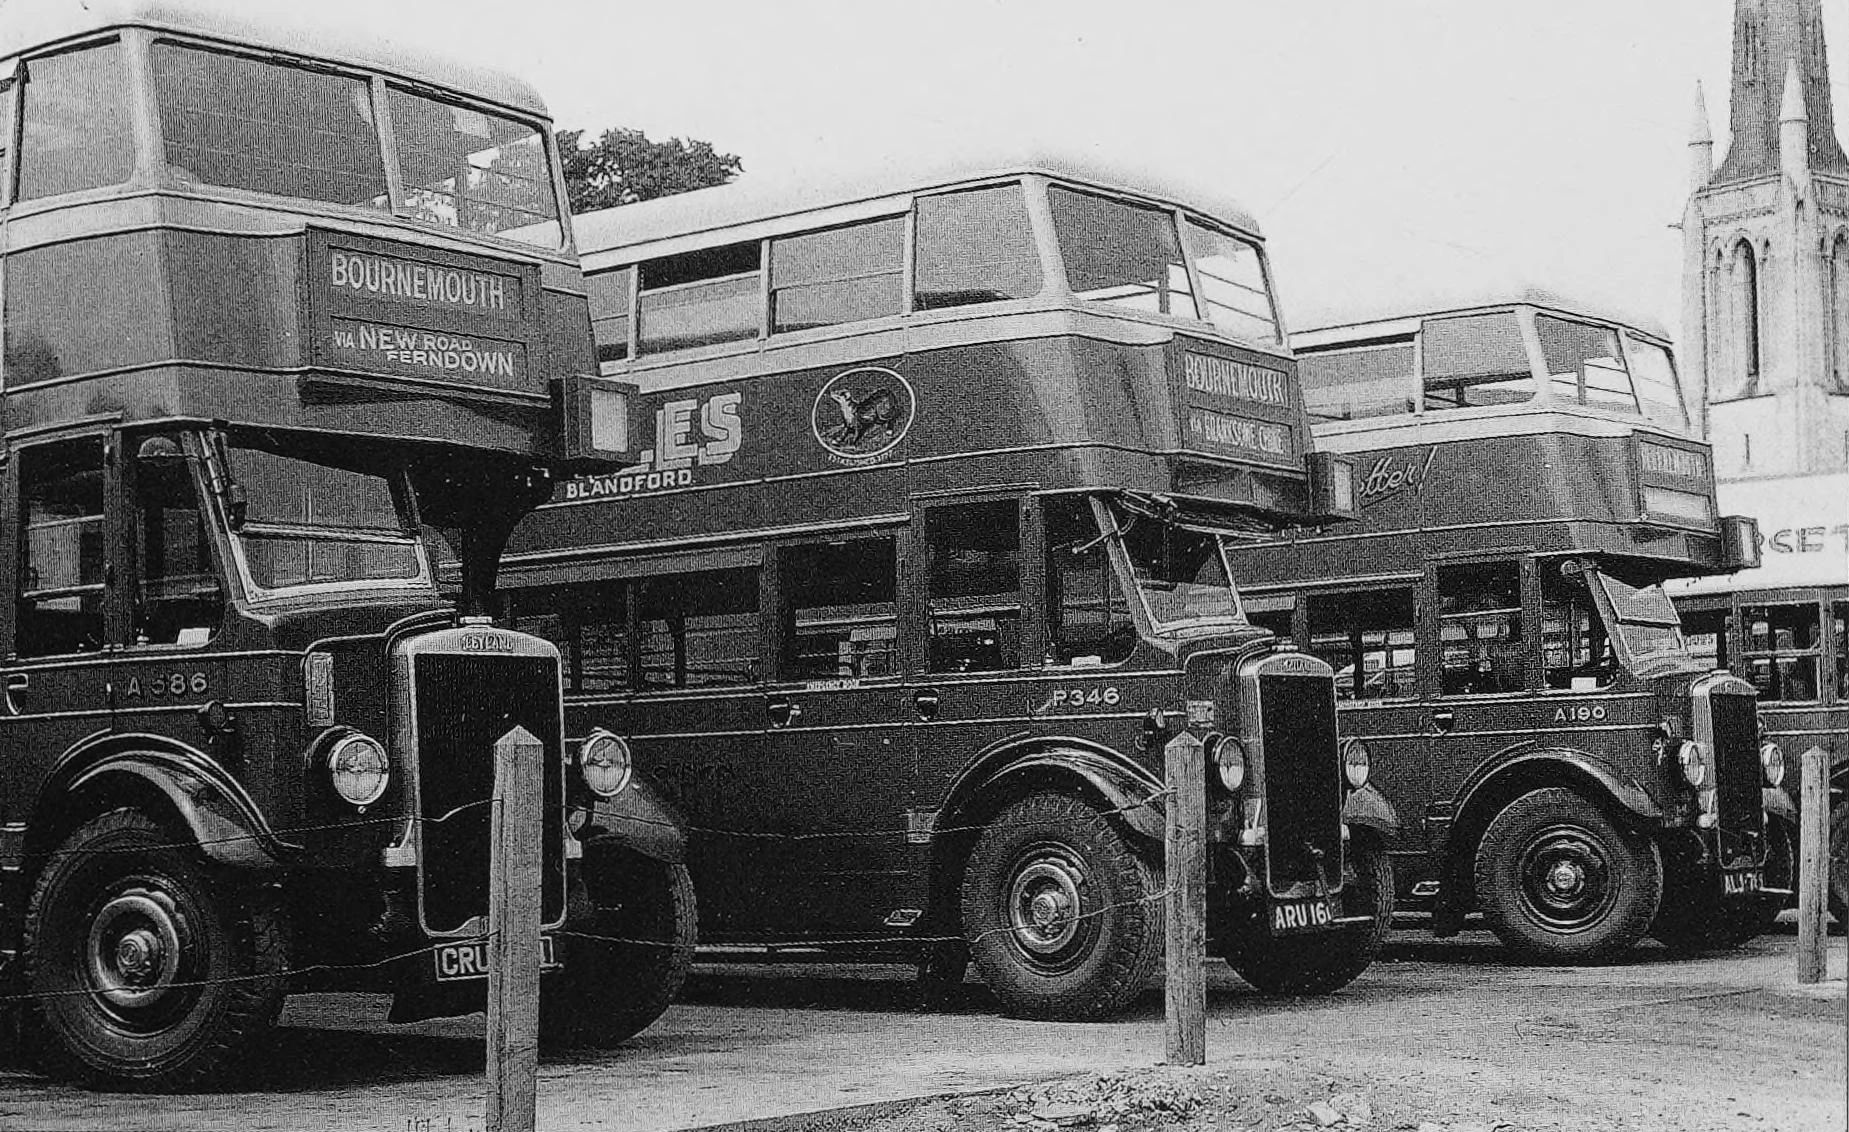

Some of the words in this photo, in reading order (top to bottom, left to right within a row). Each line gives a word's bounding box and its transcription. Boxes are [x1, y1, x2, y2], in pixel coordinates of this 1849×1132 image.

[331, 252, 504, 310] BOURNEMOUTH
[334, 330, 355, 349] VIA
[359, 324, 419, 351] NEW
[424, 335, 474, 352] ROAD
[386, 350, 514, 377] FERNDOWN
[1184, 354, 1288, 405] BOURNEMOUTH
[1053, 686, 1120, 707] P346
[1554, 705, 1606, 722] A190
[1275, 903, 1307, 930] ARU
[442, 945, 492, 976] CRU
